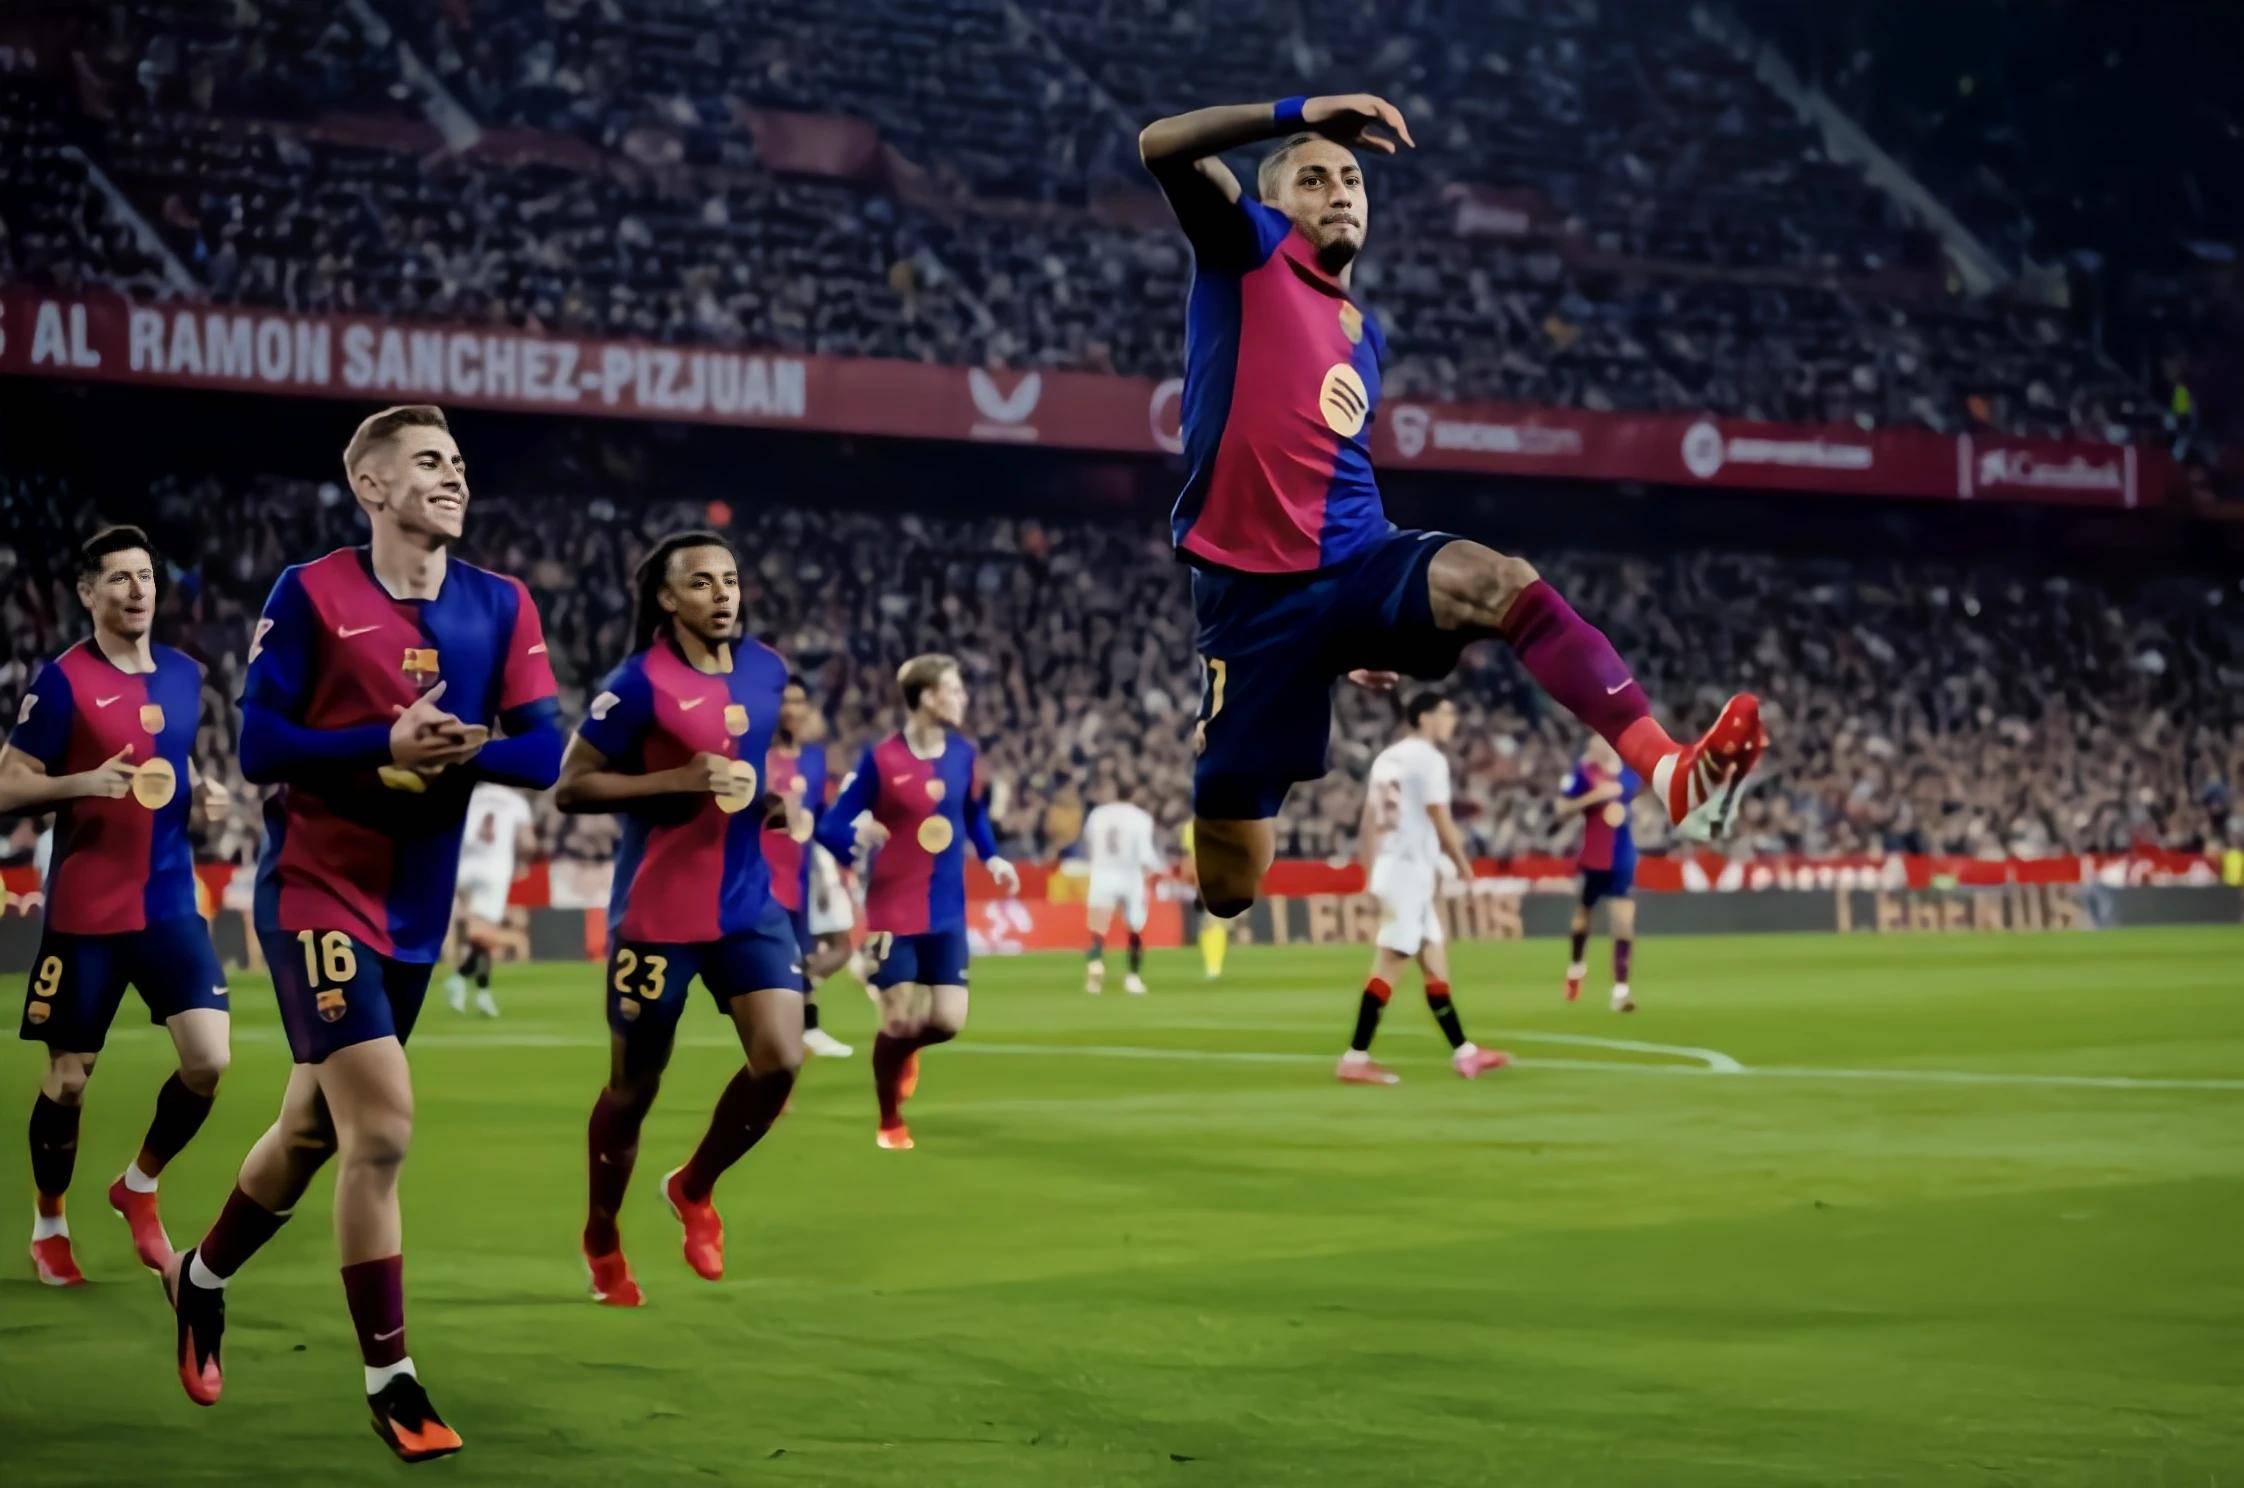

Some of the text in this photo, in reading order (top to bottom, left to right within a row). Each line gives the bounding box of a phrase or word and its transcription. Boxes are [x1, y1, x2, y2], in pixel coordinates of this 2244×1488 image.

[31, 301, 101, 367] AL
[129, 307, 331, 385] RAMON
[342, 322, 806, 418] SANCHEZ-PIZJUAN
[34, 955, 63, 998] 9
[296, 929, 357, 988] 16
[614, 948, 668, 1000] 23
